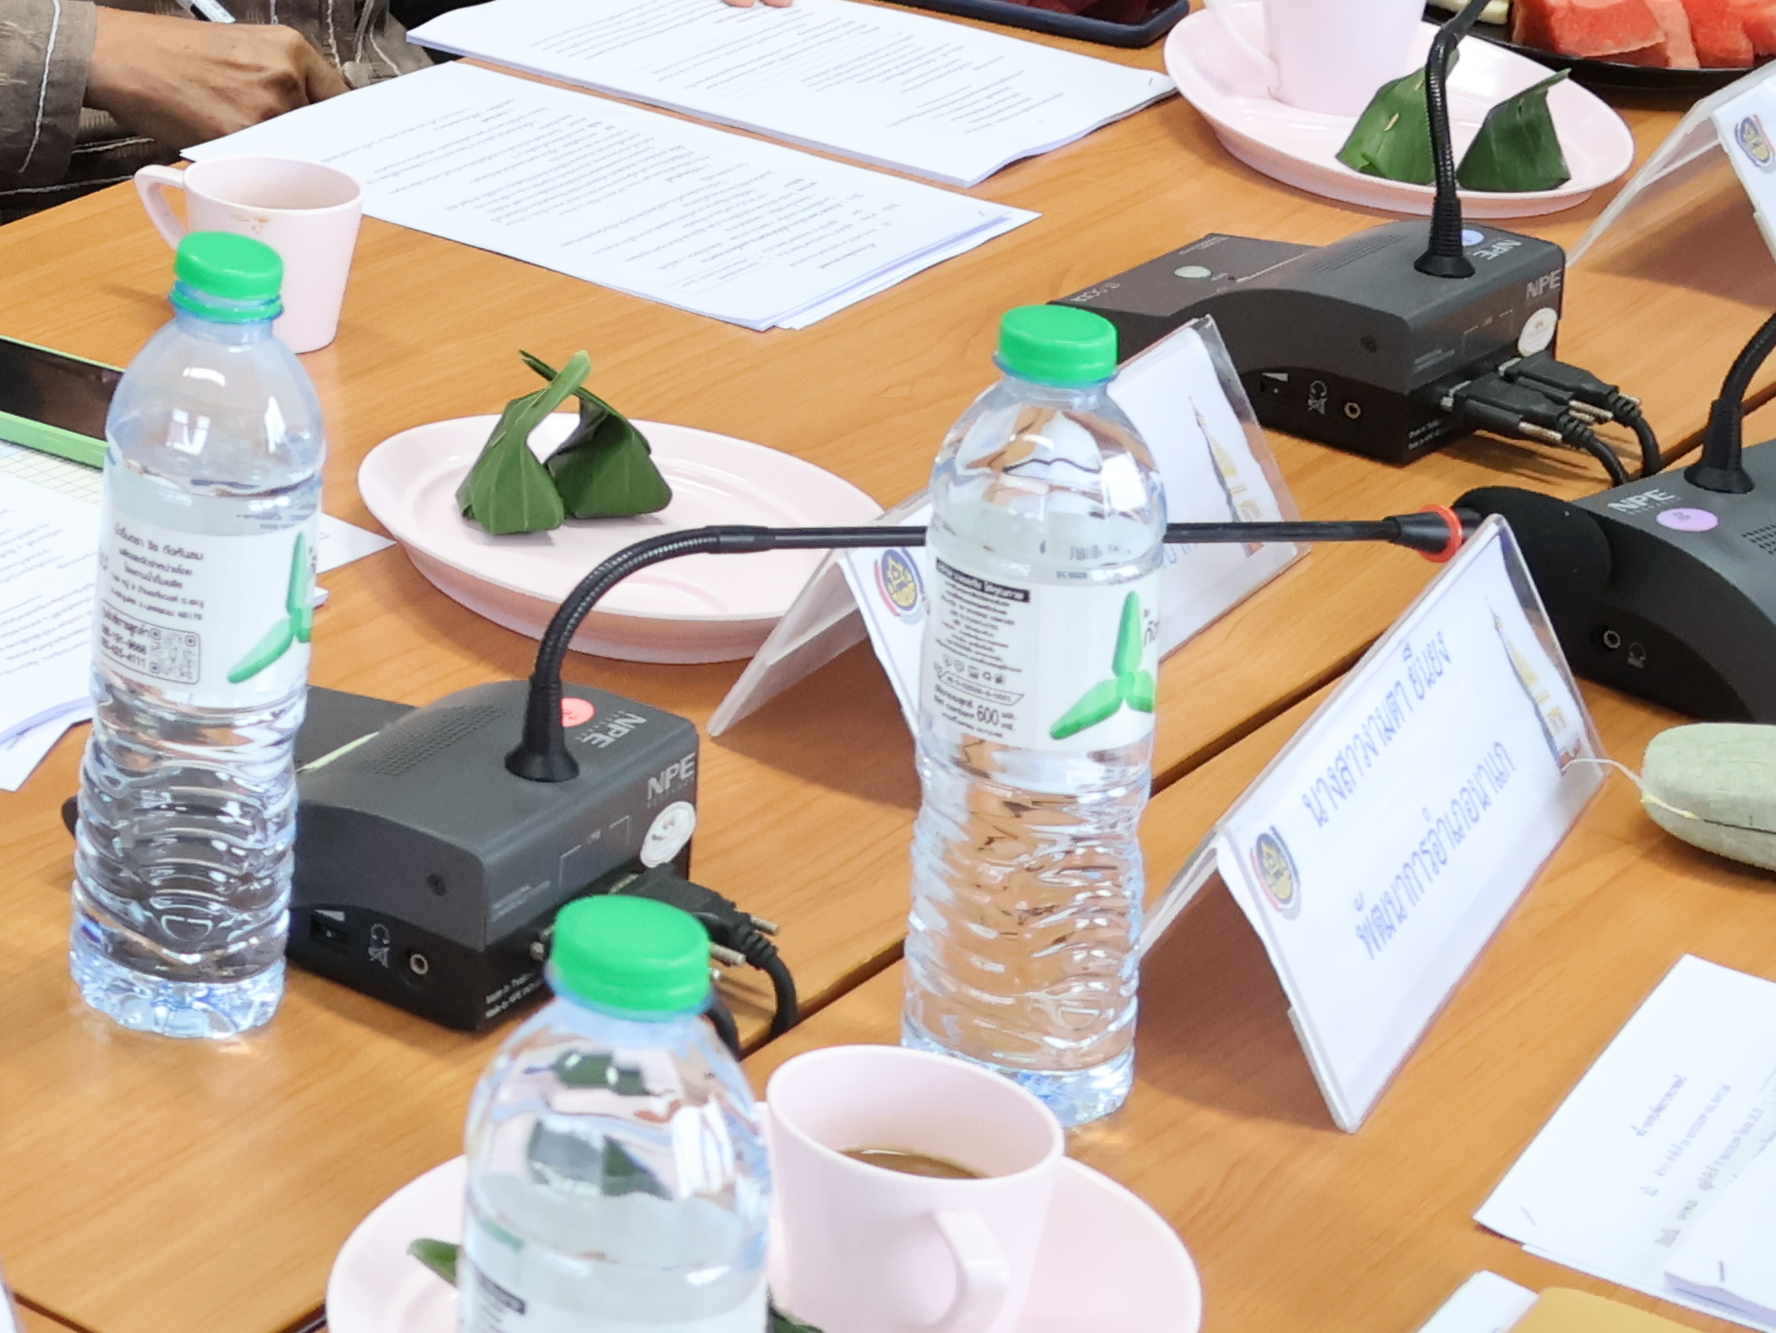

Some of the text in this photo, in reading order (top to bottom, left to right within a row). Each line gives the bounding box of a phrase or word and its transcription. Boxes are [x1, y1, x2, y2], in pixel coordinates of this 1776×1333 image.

[1525, 269, 1563, 300] NPE
[1608, 487, 1676, 514] NPE
[586, 711, 648, 749] NPE
[647, 752, 696, 796] NPE
[1301, 679, 1415, 829] นางสาวงามตา
[1352, 741, 1517, 962] พัฒนาการอำเภอนาแก
